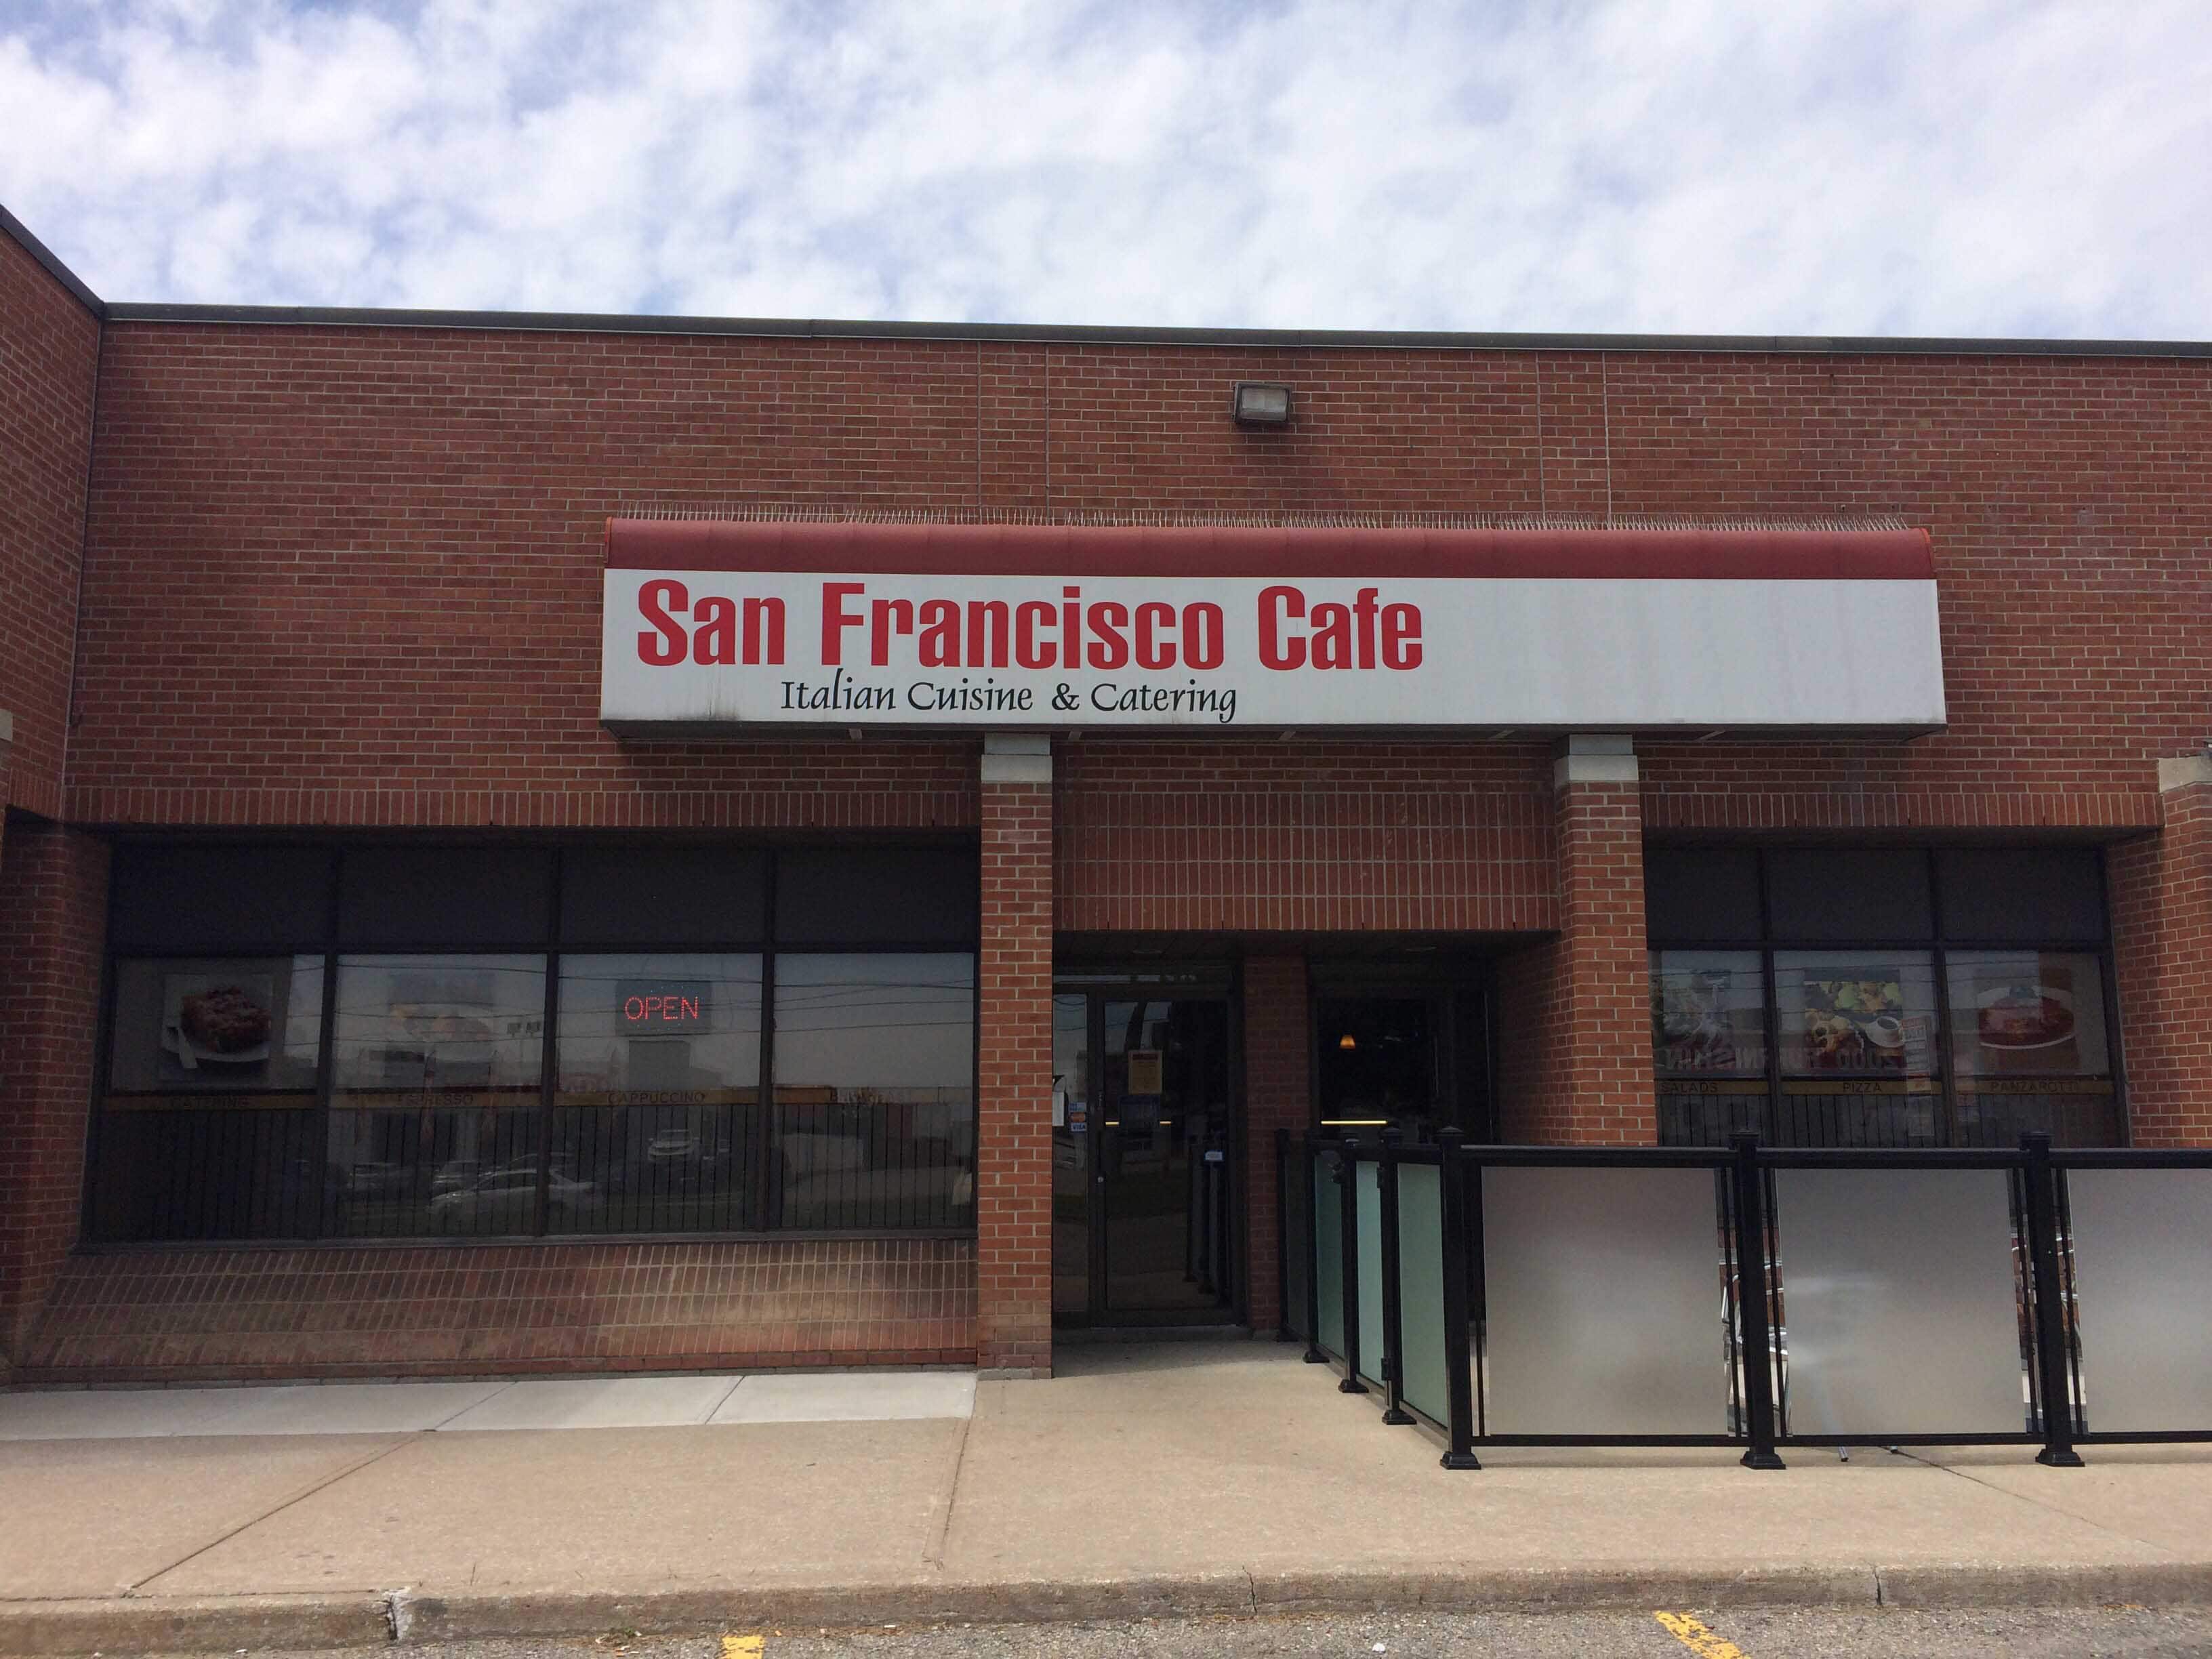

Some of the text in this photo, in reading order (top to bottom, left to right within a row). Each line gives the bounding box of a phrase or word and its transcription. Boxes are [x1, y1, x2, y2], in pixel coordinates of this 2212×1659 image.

[638, 579, 1422, 670] San Francisco Cafe
[780, 668, 1237, 724] Italian Cuisine & Catering
[624, 996, 699, 1020] OPEN
[1660, 1082, 1719, 1093] SALADS
[1842, 1082, 1883, 1092] PIZZA
[397, 1094, 474, 1105] ESPRESSO
[607, 1091, 705, 1104] CAPPUCCINO
